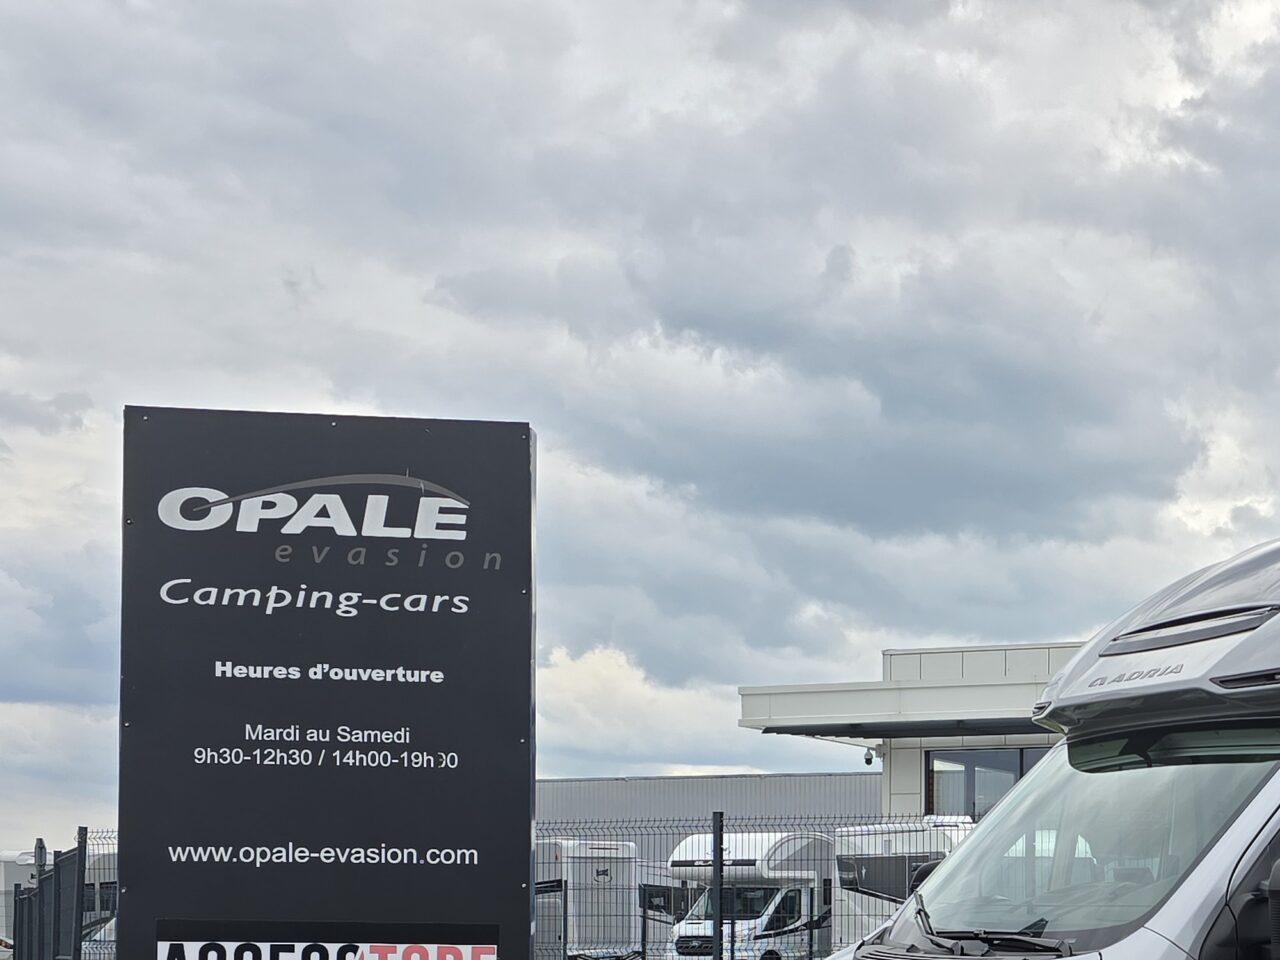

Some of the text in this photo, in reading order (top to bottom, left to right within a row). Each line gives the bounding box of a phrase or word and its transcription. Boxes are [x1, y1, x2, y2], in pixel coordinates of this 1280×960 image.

[158, 487, 468, 540] OPALE
[274, 543, 501, 570] evasion
[160, 578, 470, 616] Camping-cars
[215, 661, 444, 683] Heures d'ouverture
[1107, 663, 1184, 685] ADRIA
[246, 724, 410, 743] Mardi au Samedi
[194, 748, 312, 766] 9h30-12h30
[317, 749, 326, 766] /
[168, 842, 478, 867] www.opale-evasion.com
